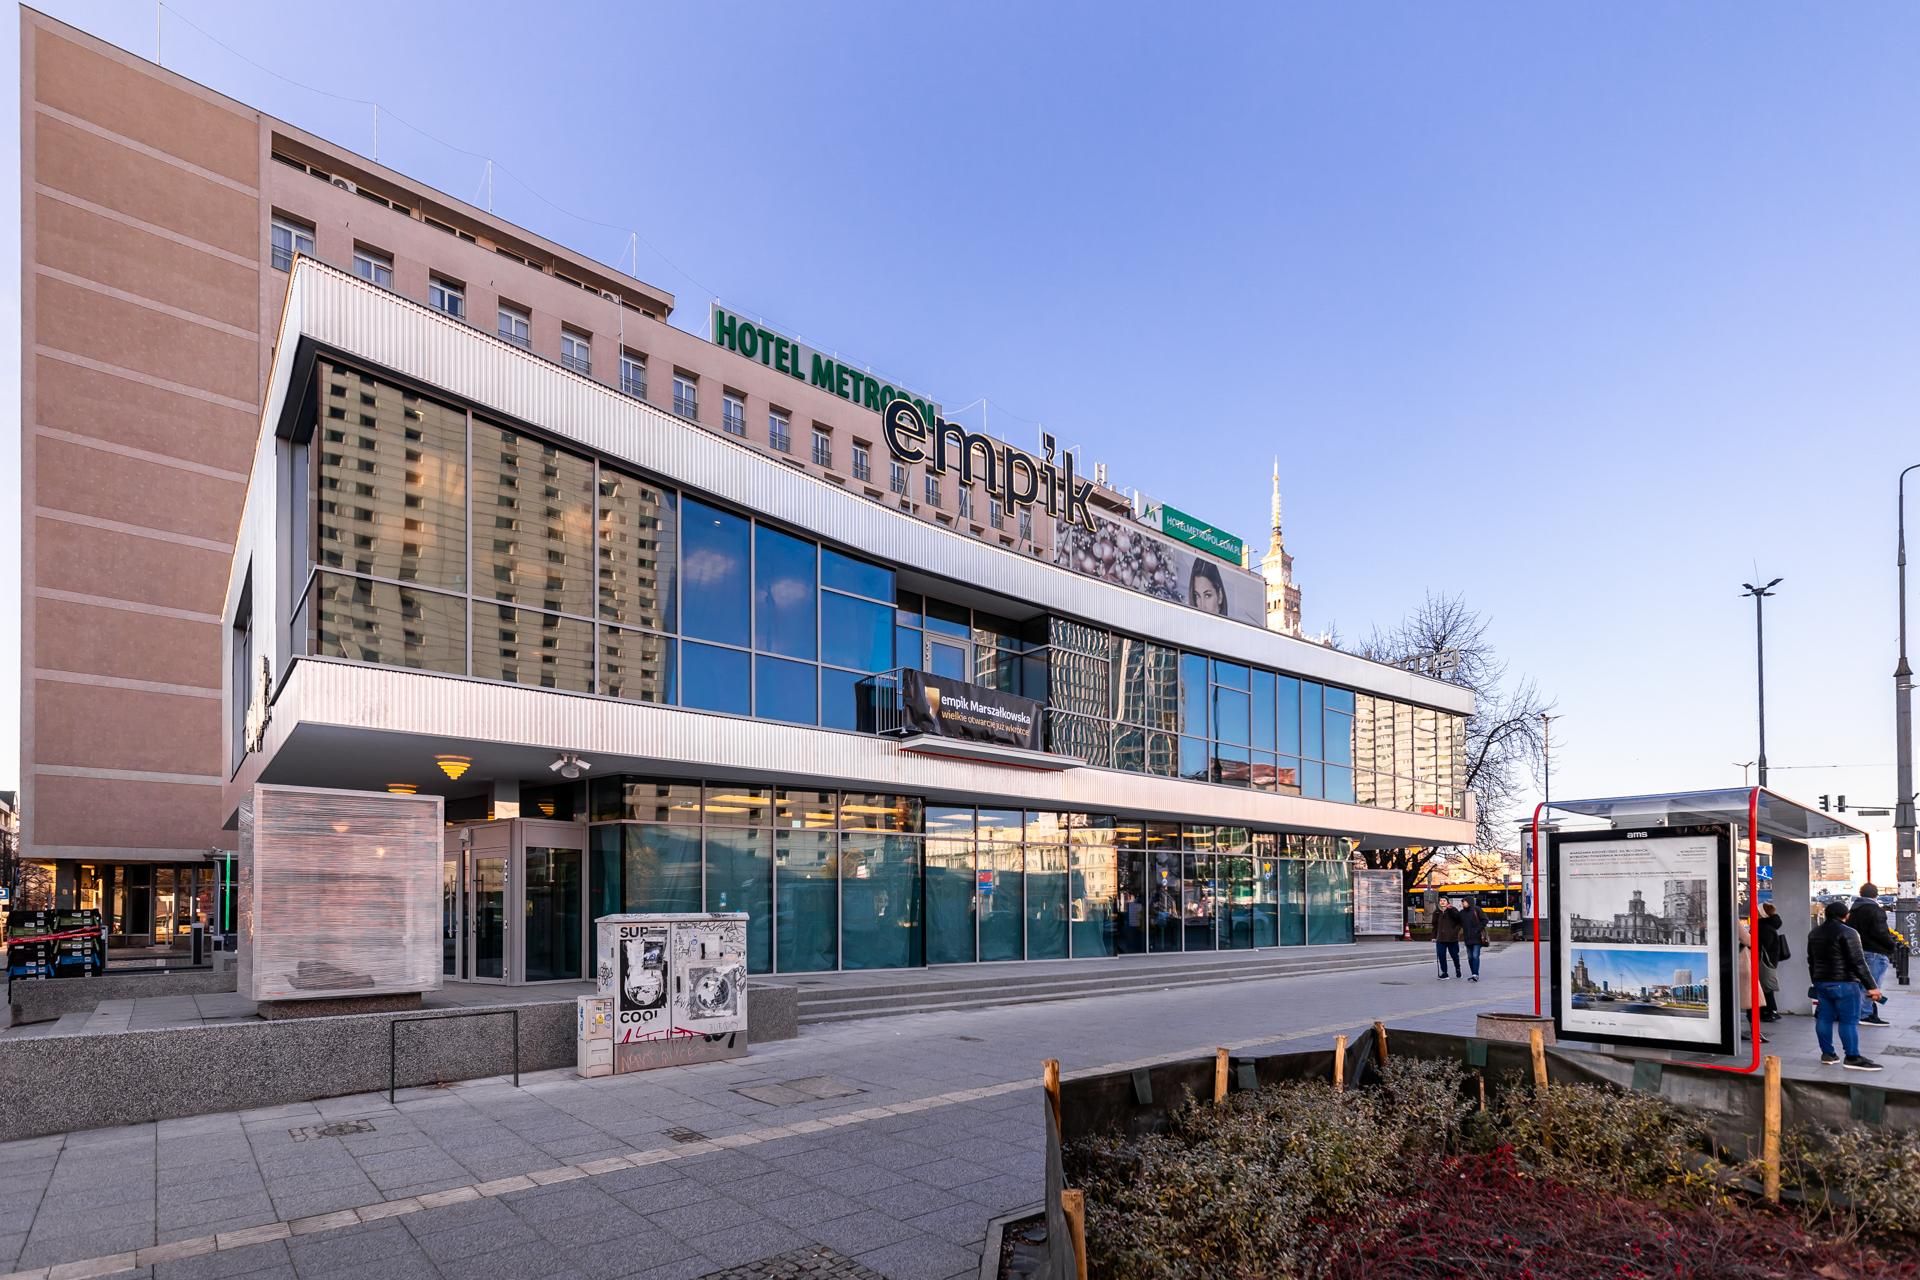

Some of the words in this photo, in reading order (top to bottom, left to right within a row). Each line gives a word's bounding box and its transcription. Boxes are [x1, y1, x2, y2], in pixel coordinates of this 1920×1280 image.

[716, 309, 805, 381] HOTEL
[882, 398, 1097, 532] empik
[941, 695, 969, 710] empik
[970, 700, 1031, 724] Marszałkowska
[941, 710, 967, 722] wielkie
[968, 716, 996, 728] otwarcie
[996, 721, 1005, 731] już
[1626, 831, 1648, 839] ams
[620, 926, 665, 938] SUP
